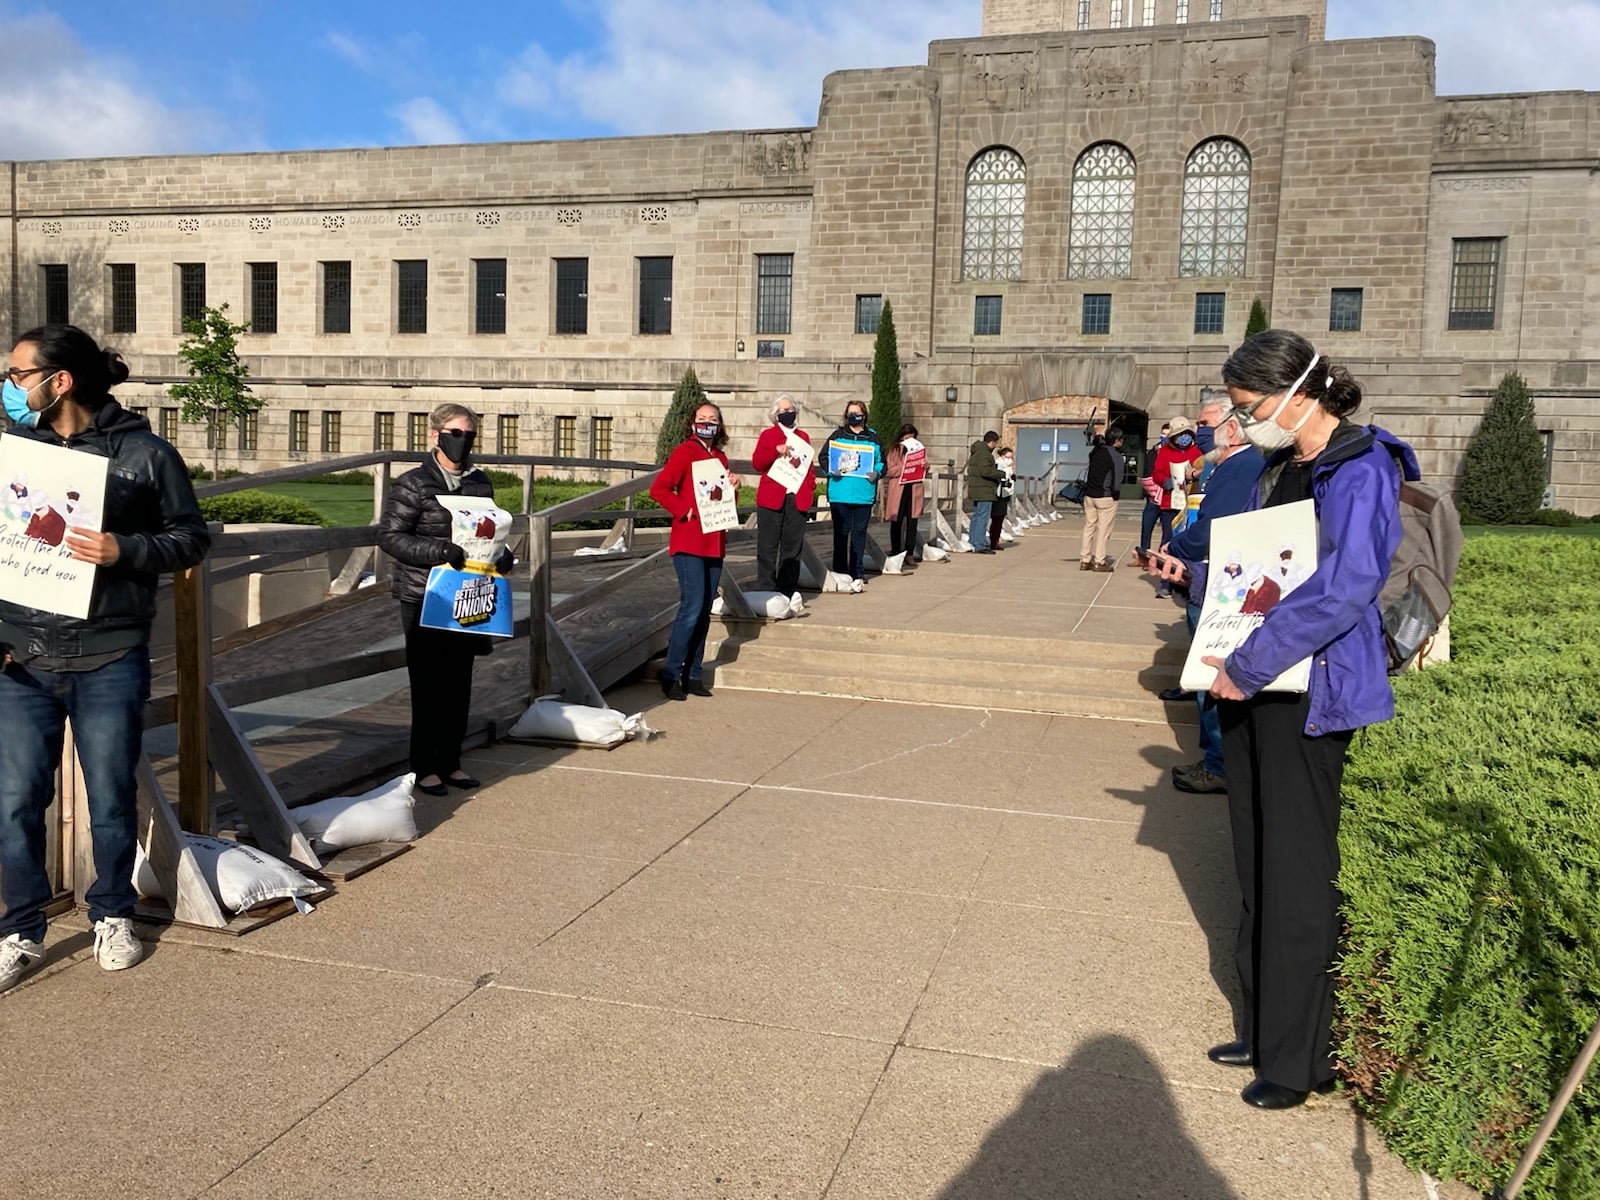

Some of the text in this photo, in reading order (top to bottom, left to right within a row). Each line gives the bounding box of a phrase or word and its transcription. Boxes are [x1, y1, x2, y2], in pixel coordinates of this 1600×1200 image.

[741, 203, 809, 214] LANCASTER
[427, 213, 469, 223] CUSTER
[506, 211, 550, 221] GOSPER
[134, 219, 173, 229] CUMING
[1, 553, 19, 568] who
[24, 561, 52, 577] feed
[456, 585, 480, 600] BETTER
[453, 593, 495, 619] UNIONS
[1198, 609, 1246, 632] Protect
[1205, 635, 1230, 649] who
